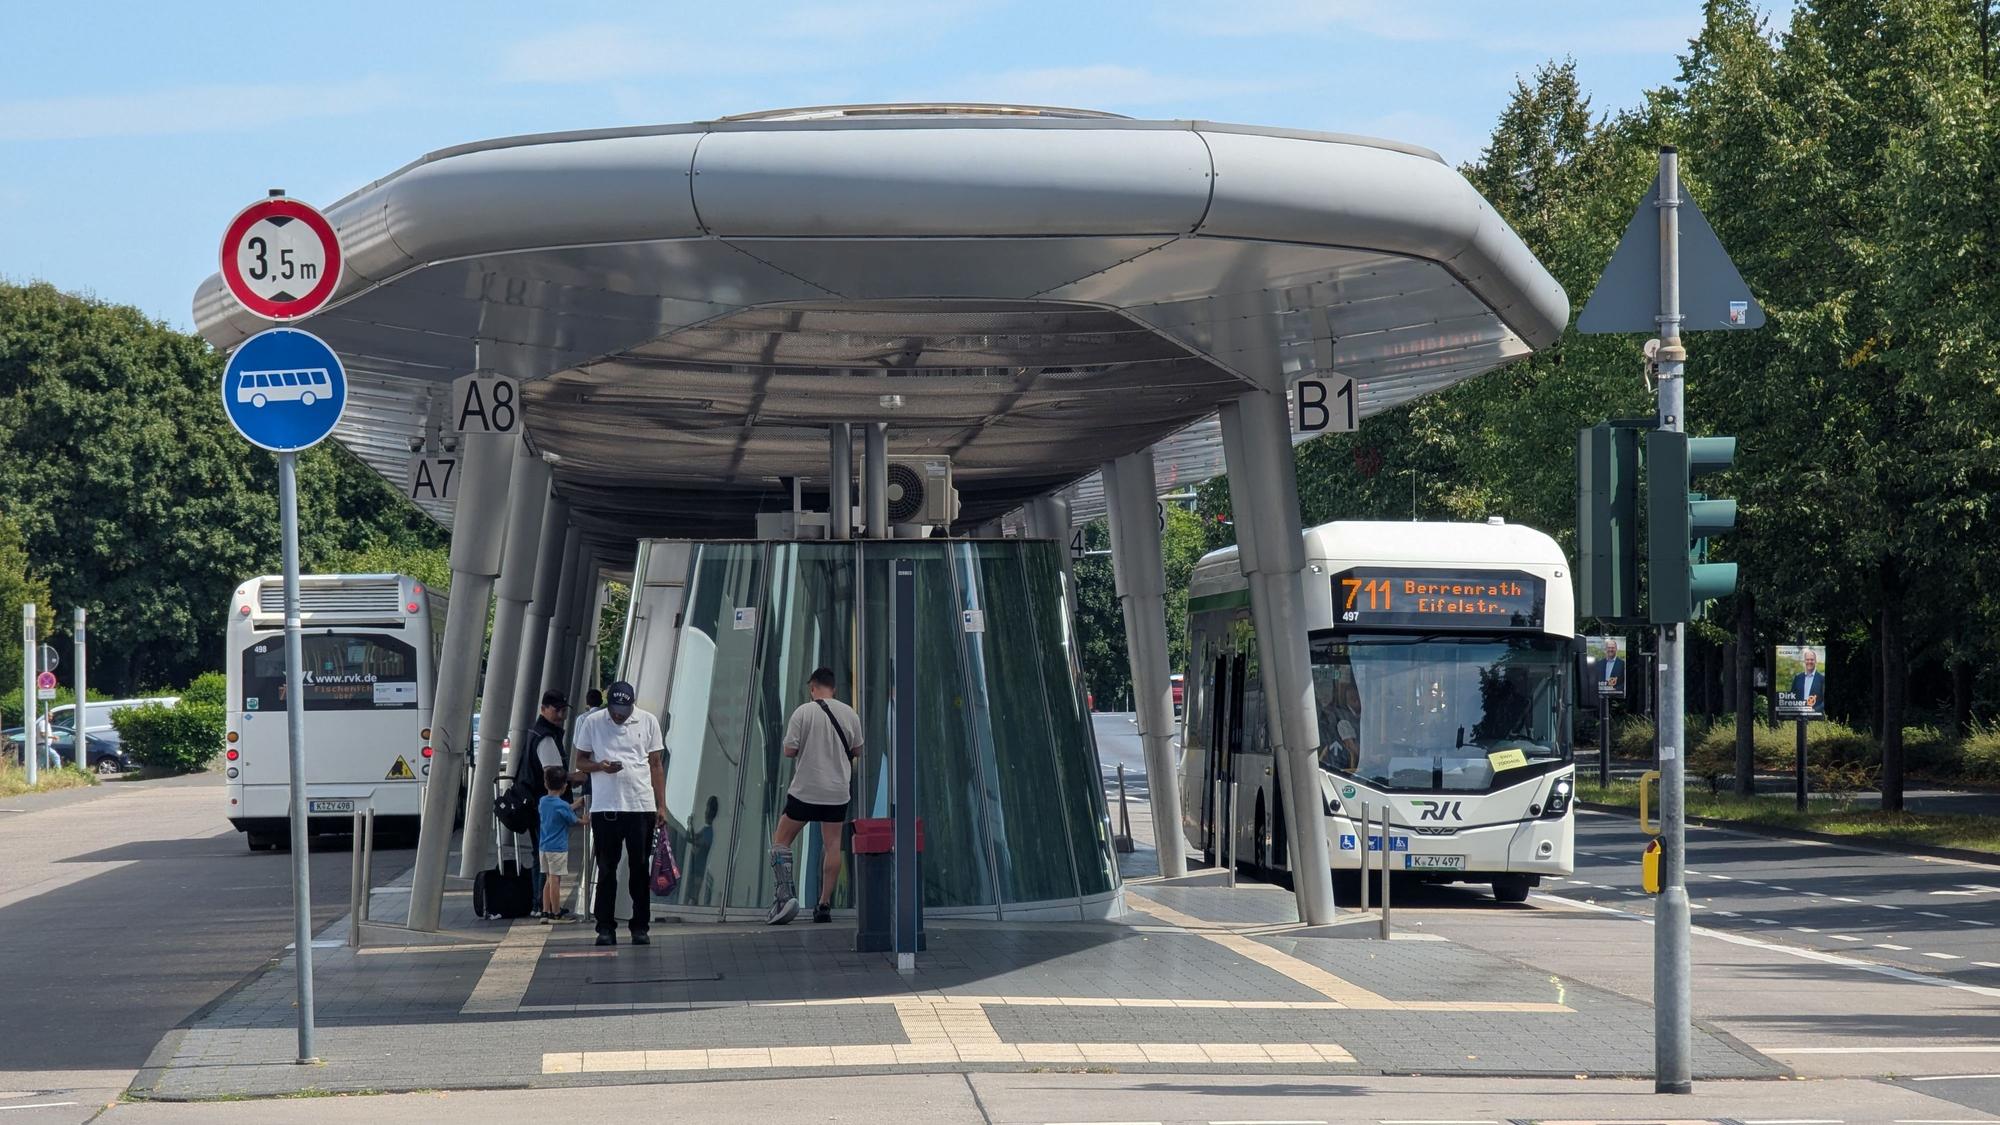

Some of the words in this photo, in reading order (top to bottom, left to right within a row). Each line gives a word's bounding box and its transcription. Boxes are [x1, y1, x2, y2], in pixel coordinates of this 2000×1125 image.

[248, 236, 294, 282] 3,5
[301, 263, 317, 279] m
[458, 380, 515, 432] A8
[1298, 378, 1354, 431] B1
[412, 459, 455, 498] A7
[1070, 529, 1084, 557] 4
[1341, 579, 1392, 610] 711
[1405, 580, 1521, 596] Berrenrath
[1418, 598, 1506, 613] Eifelstr.
[1342, 611, 1359, 622] 497
[254, 645, 267, 653] 498
[315, 673, 378, 683] www.rvk.de
[1778, 692, 1796, 700] Dirk
[316, 802, 322, 810] K
[326, 802, 336, 810] ZY
[1414, 857, 1421, 866] K
[1427, 857, 1441, 866] ZY
[1441, 857, 1460, 866] 497
